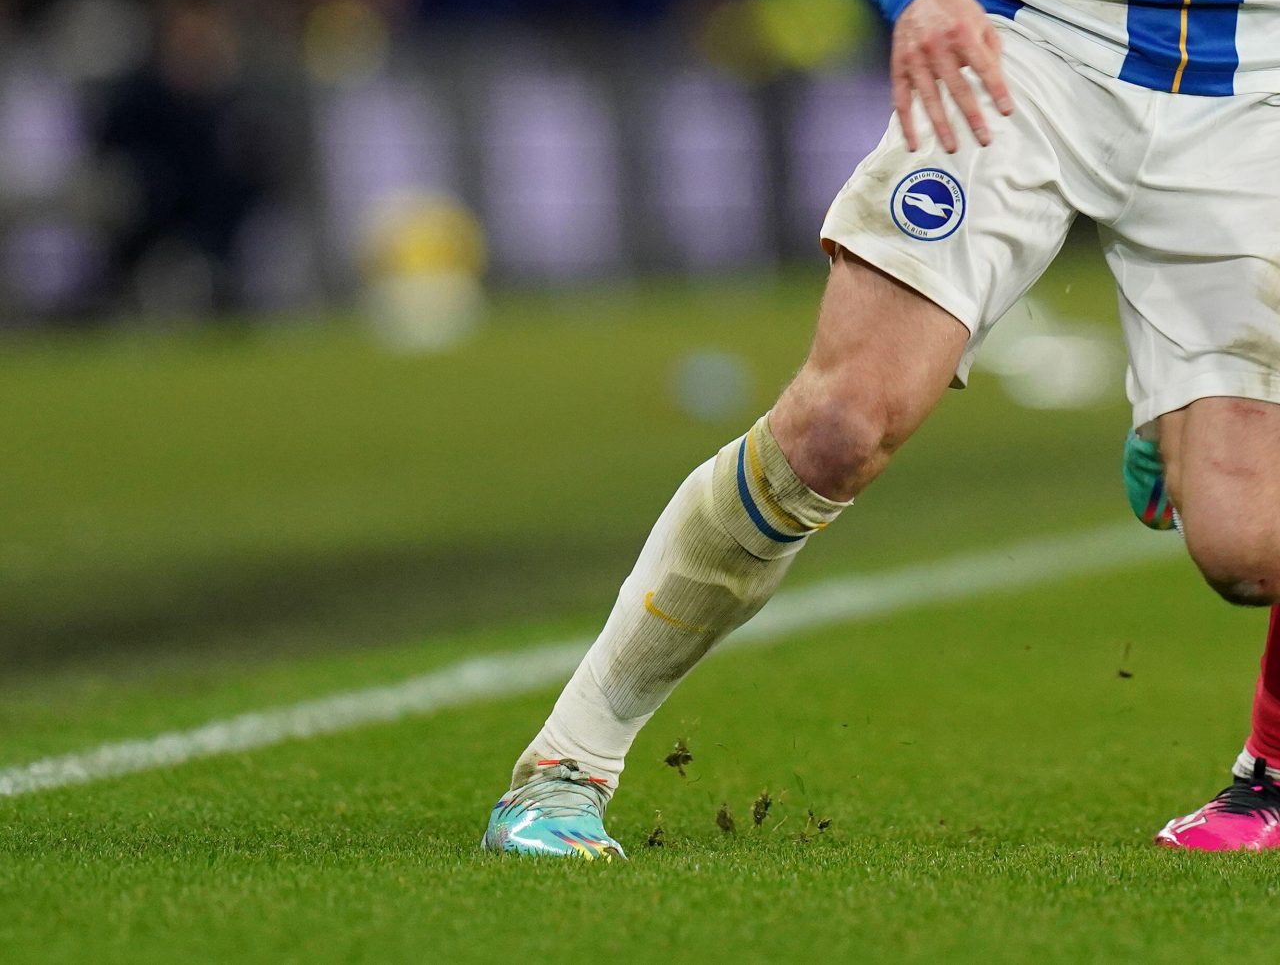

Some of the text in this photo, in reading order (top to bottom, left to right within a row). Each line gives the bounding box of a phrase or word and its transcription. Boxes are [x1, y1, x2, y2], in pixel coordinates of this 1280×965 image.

[909, 172, 945, 184] BRIGHTON
[951, 185, 961, 203] HOVE
[903, 222, 928, 237] ALBION
